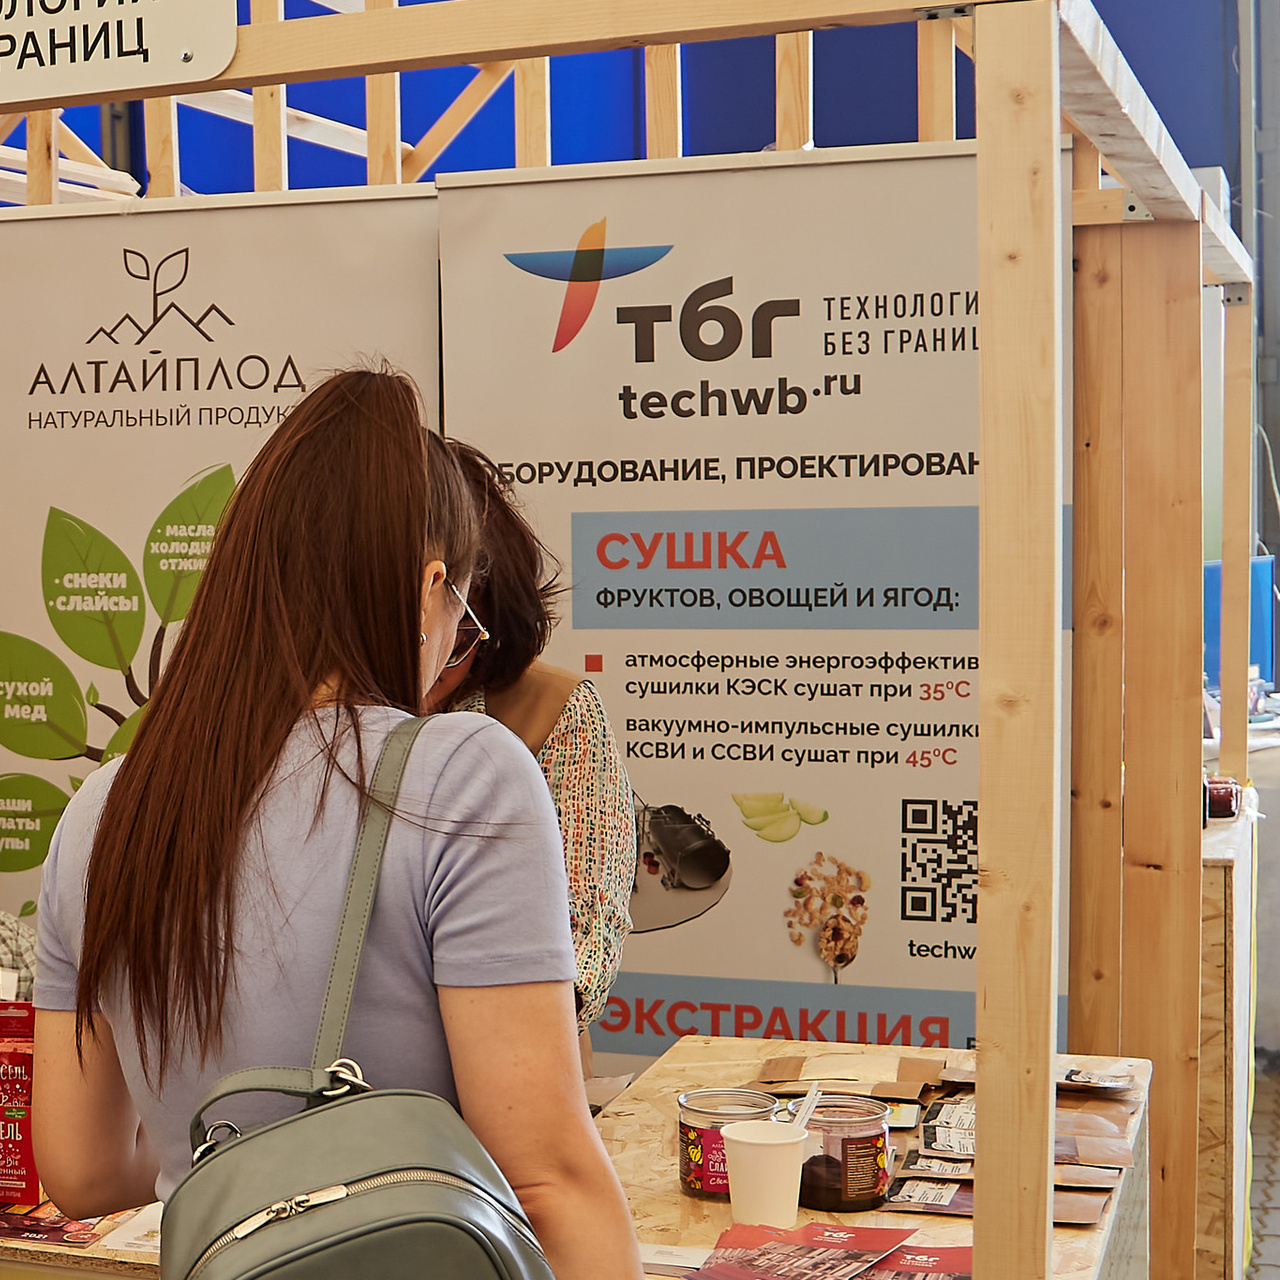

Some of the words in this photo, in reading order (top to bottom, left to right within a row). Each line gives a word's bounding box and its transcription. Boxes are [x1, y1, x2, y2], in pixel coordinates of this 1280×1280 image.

[617, 276, 800, 363] тбг
[824, 332, 870, 356] БЕЗ
[28, 351, 306, 395] АЛТАЙПЛОД
[619, 373, 862, 420] techwb.ru
[27, 405, 192, 430] НАТУРАЛЬНЫЙ
[596, 531, 787, 570] СУШКА
[63, 573, 127, 589] снеки
[56, 590, 138, 612] слайсы
[596, 587, 720, 610] ФРУКТОВ,
[728, 583, 847, 611] ОВОЩЕЙ
[857, 588, 875, 607] И
[883, 587, 959, 611] ЯГОД:
[625, 652, 779, 673] атмосферные
[625, 679, 719, 696] сушилки
[726, 679, 788, 697] КЭСК
[794, 681, 863, 701] сушат
[870, 683, 912, 702] при
[4, 704, 47, 721] мед
[626, 718, 880, 738] вакуумно-импульсные
[626, 741, 685, 760] КСВИ
[692, 745, 704, 760] и
[711, 743, 774, 762] ССВИ
[781, 746, 849, 766] сушат
[856, 750, 899, 768] при
